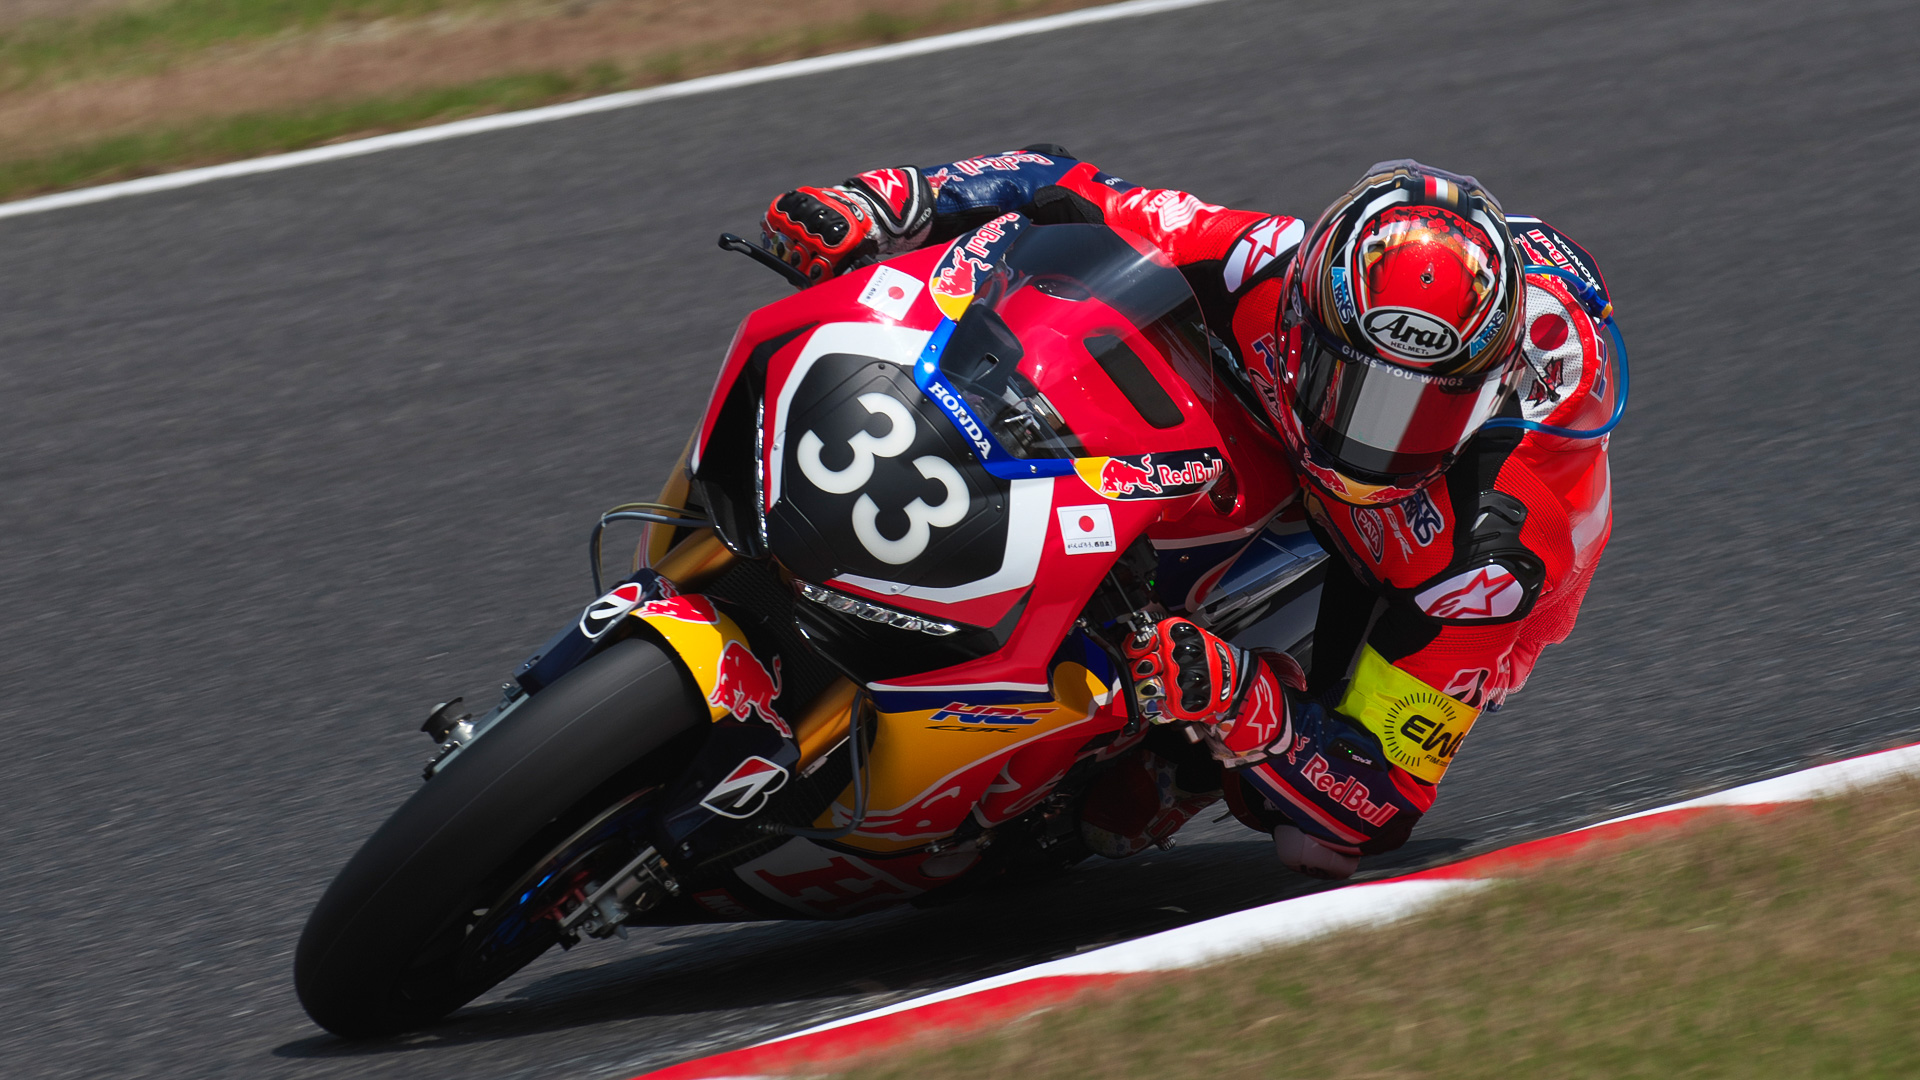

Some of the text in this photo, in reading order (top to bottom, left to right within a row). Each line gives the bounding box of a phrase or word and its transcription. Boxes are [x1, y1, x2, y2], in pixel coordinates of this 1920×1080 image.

[1552, 232, 1602, 292] HONDA
[1367, 314, 1451, 350] Arai
[1341, 345, 1464, 387] GIVES YOU WINGS
[928, 382, 992, 459] HONDA
[797, 392, 970, 565] 33
[1358, 510, 1379, 550] PATA
[928, 701, 1060, 725] HRC
[1424, 755, 1441, 766] FIM
